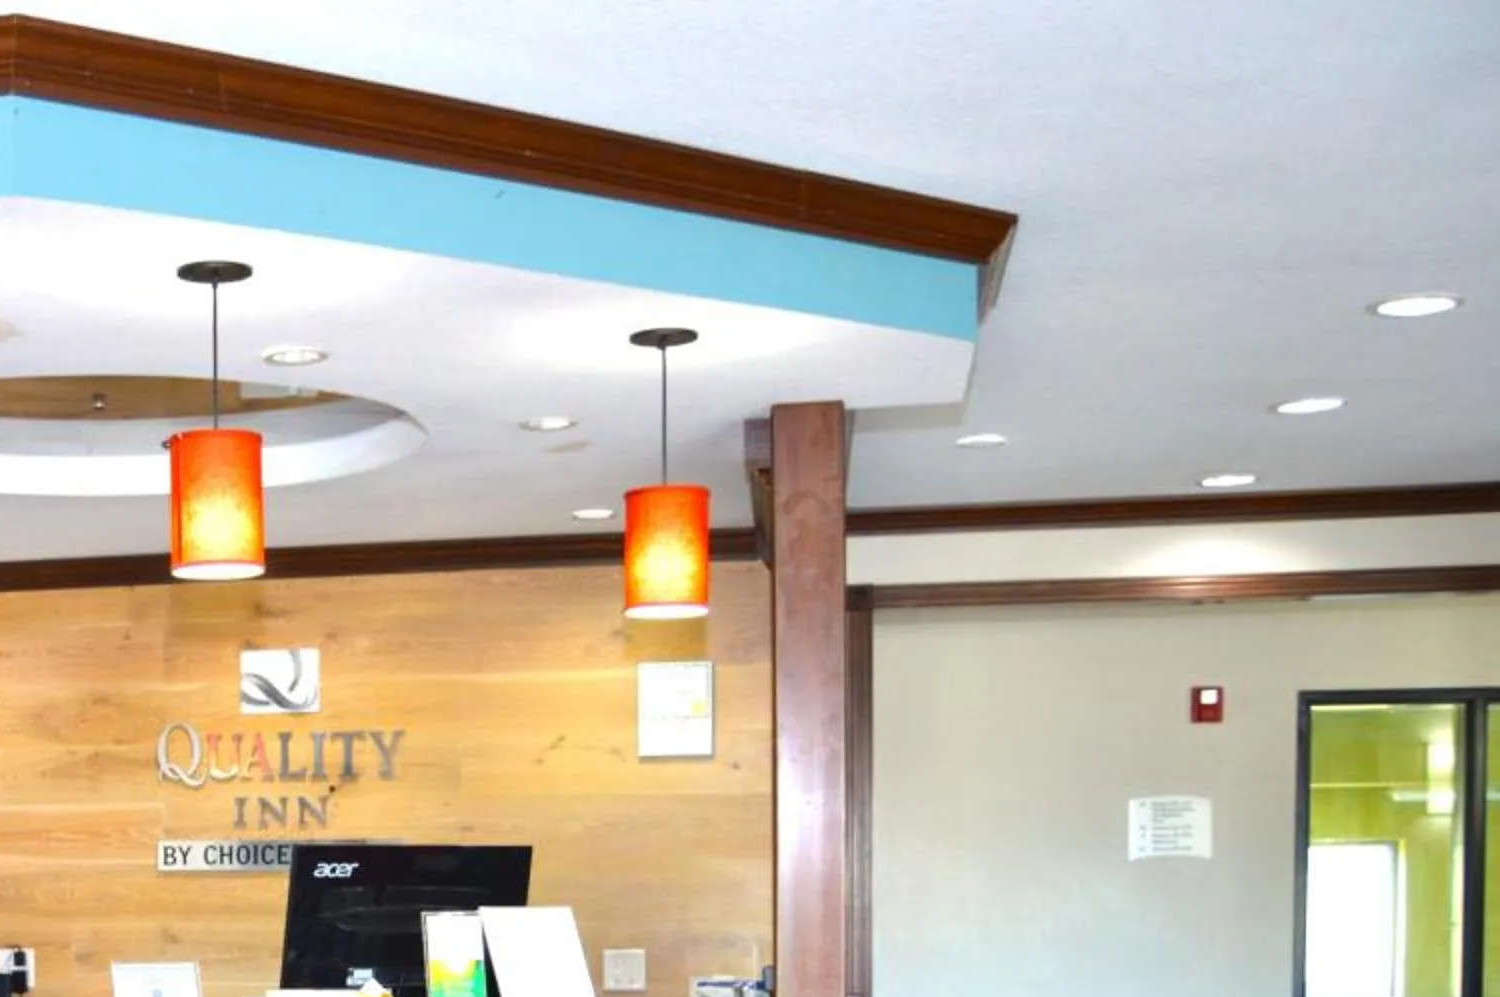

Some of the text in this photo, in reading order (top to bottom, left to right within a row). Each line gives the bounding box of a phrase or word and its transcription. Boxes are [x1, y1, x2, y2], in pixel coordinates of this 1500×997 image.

[157, 723, 406, 787] QUALITY
[233, 796, 329, 829] INN
[163, 844, 292, 867] BY CHOICE
[313, 862, 359, 879] acer
